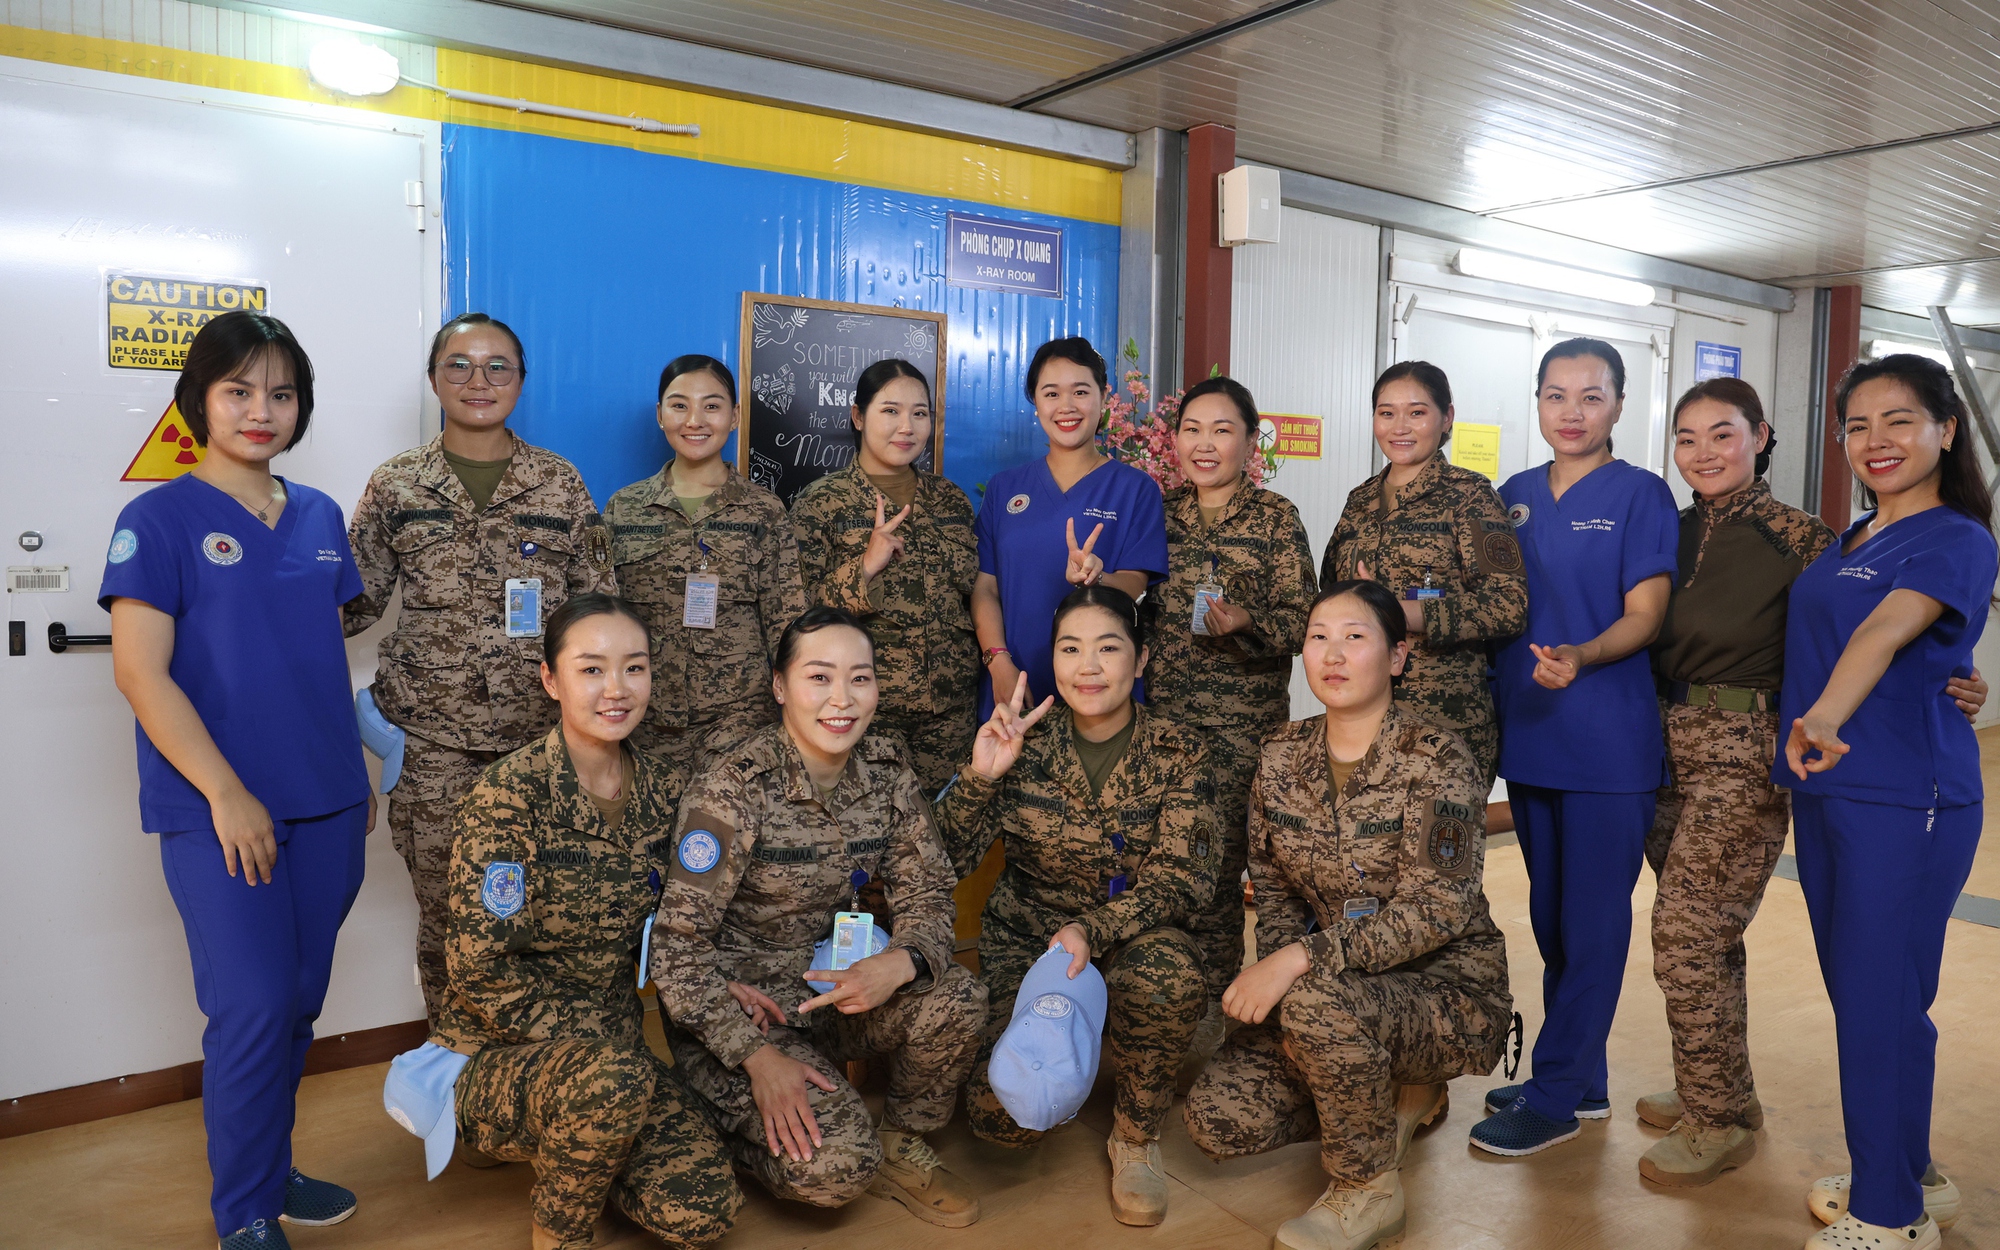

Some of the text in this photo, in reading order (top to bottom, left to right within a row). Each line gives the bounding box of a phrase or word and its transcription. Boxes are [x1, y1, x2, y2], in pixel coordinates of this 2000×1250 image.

[961, 227, 1051, 264] PHÒNG CHỤP X QUANG
[976, 265, 1036, 283] X-RAY ROOM
[110, 278, 264, 311] CAUTION
[147, 309, 218, 328] X-RA
[112, 355, 124, 363] IF
[130, 356, 157, 365] YOU
[114, 346, 187, 358] PLEASE LE
[808, 366, 858, 389] you will
[808, 410, 828, 429] the
[1280, 439, 1318, 453] NO SMOKING
[1222, 537, 1269, 552] MONGOLIA
[1750, 517, 1790, 558] MONGOLIA
